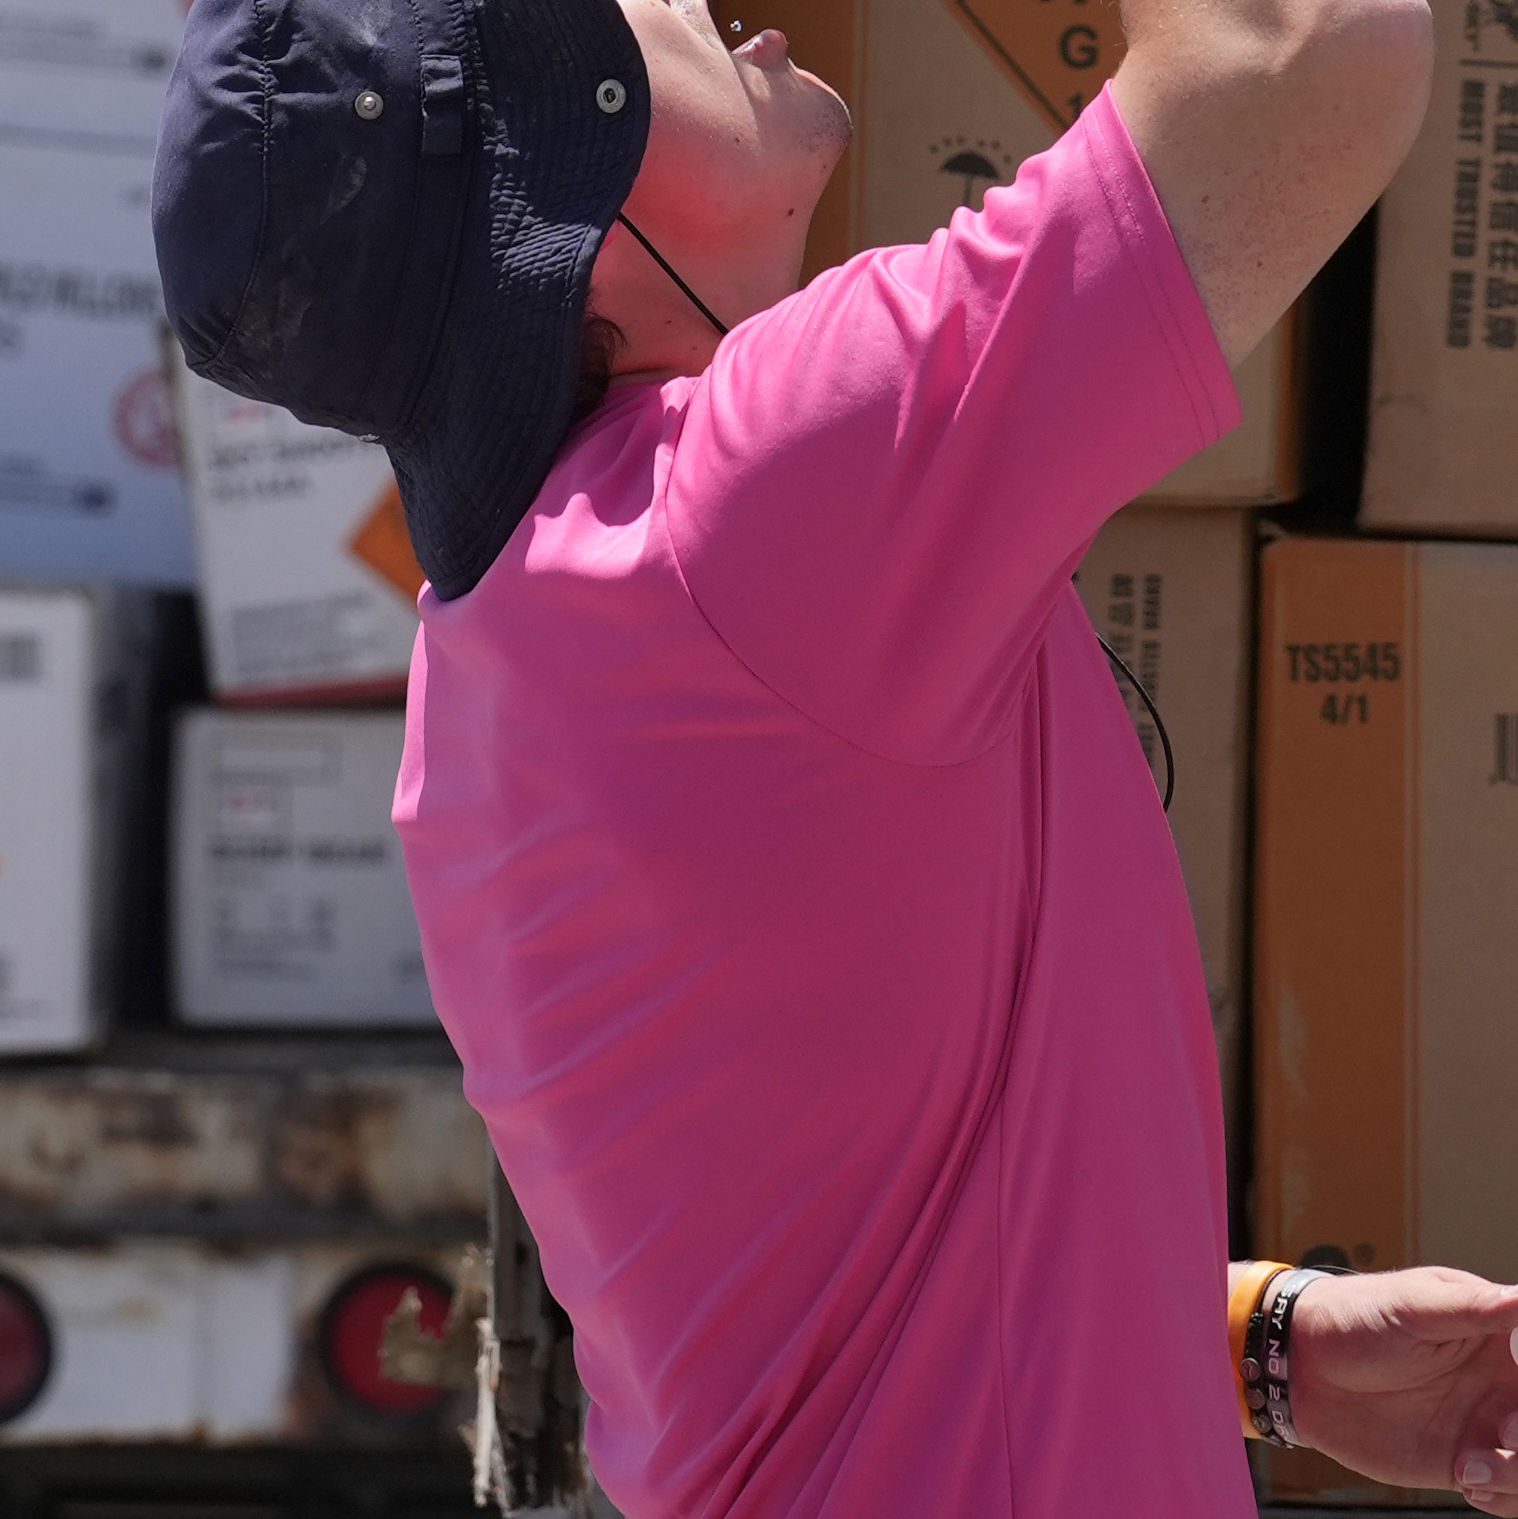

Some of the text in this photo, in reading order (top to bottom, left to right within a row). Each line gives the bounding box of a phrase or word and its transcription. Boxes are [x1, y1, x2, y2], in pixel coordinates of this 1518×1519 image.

[1057, 24, 1099, 70] G
[1458, 78, 1489, 144] MOST
[1450, 156, 1483, 258] TRUSTED
[1285, 642, 1401, 685] TS5545
[1320, 691, 1371, 727] 4/1
[1268, 1338, 1281, 1376] NO
[1268, 1384, 1281, 1402] 2
